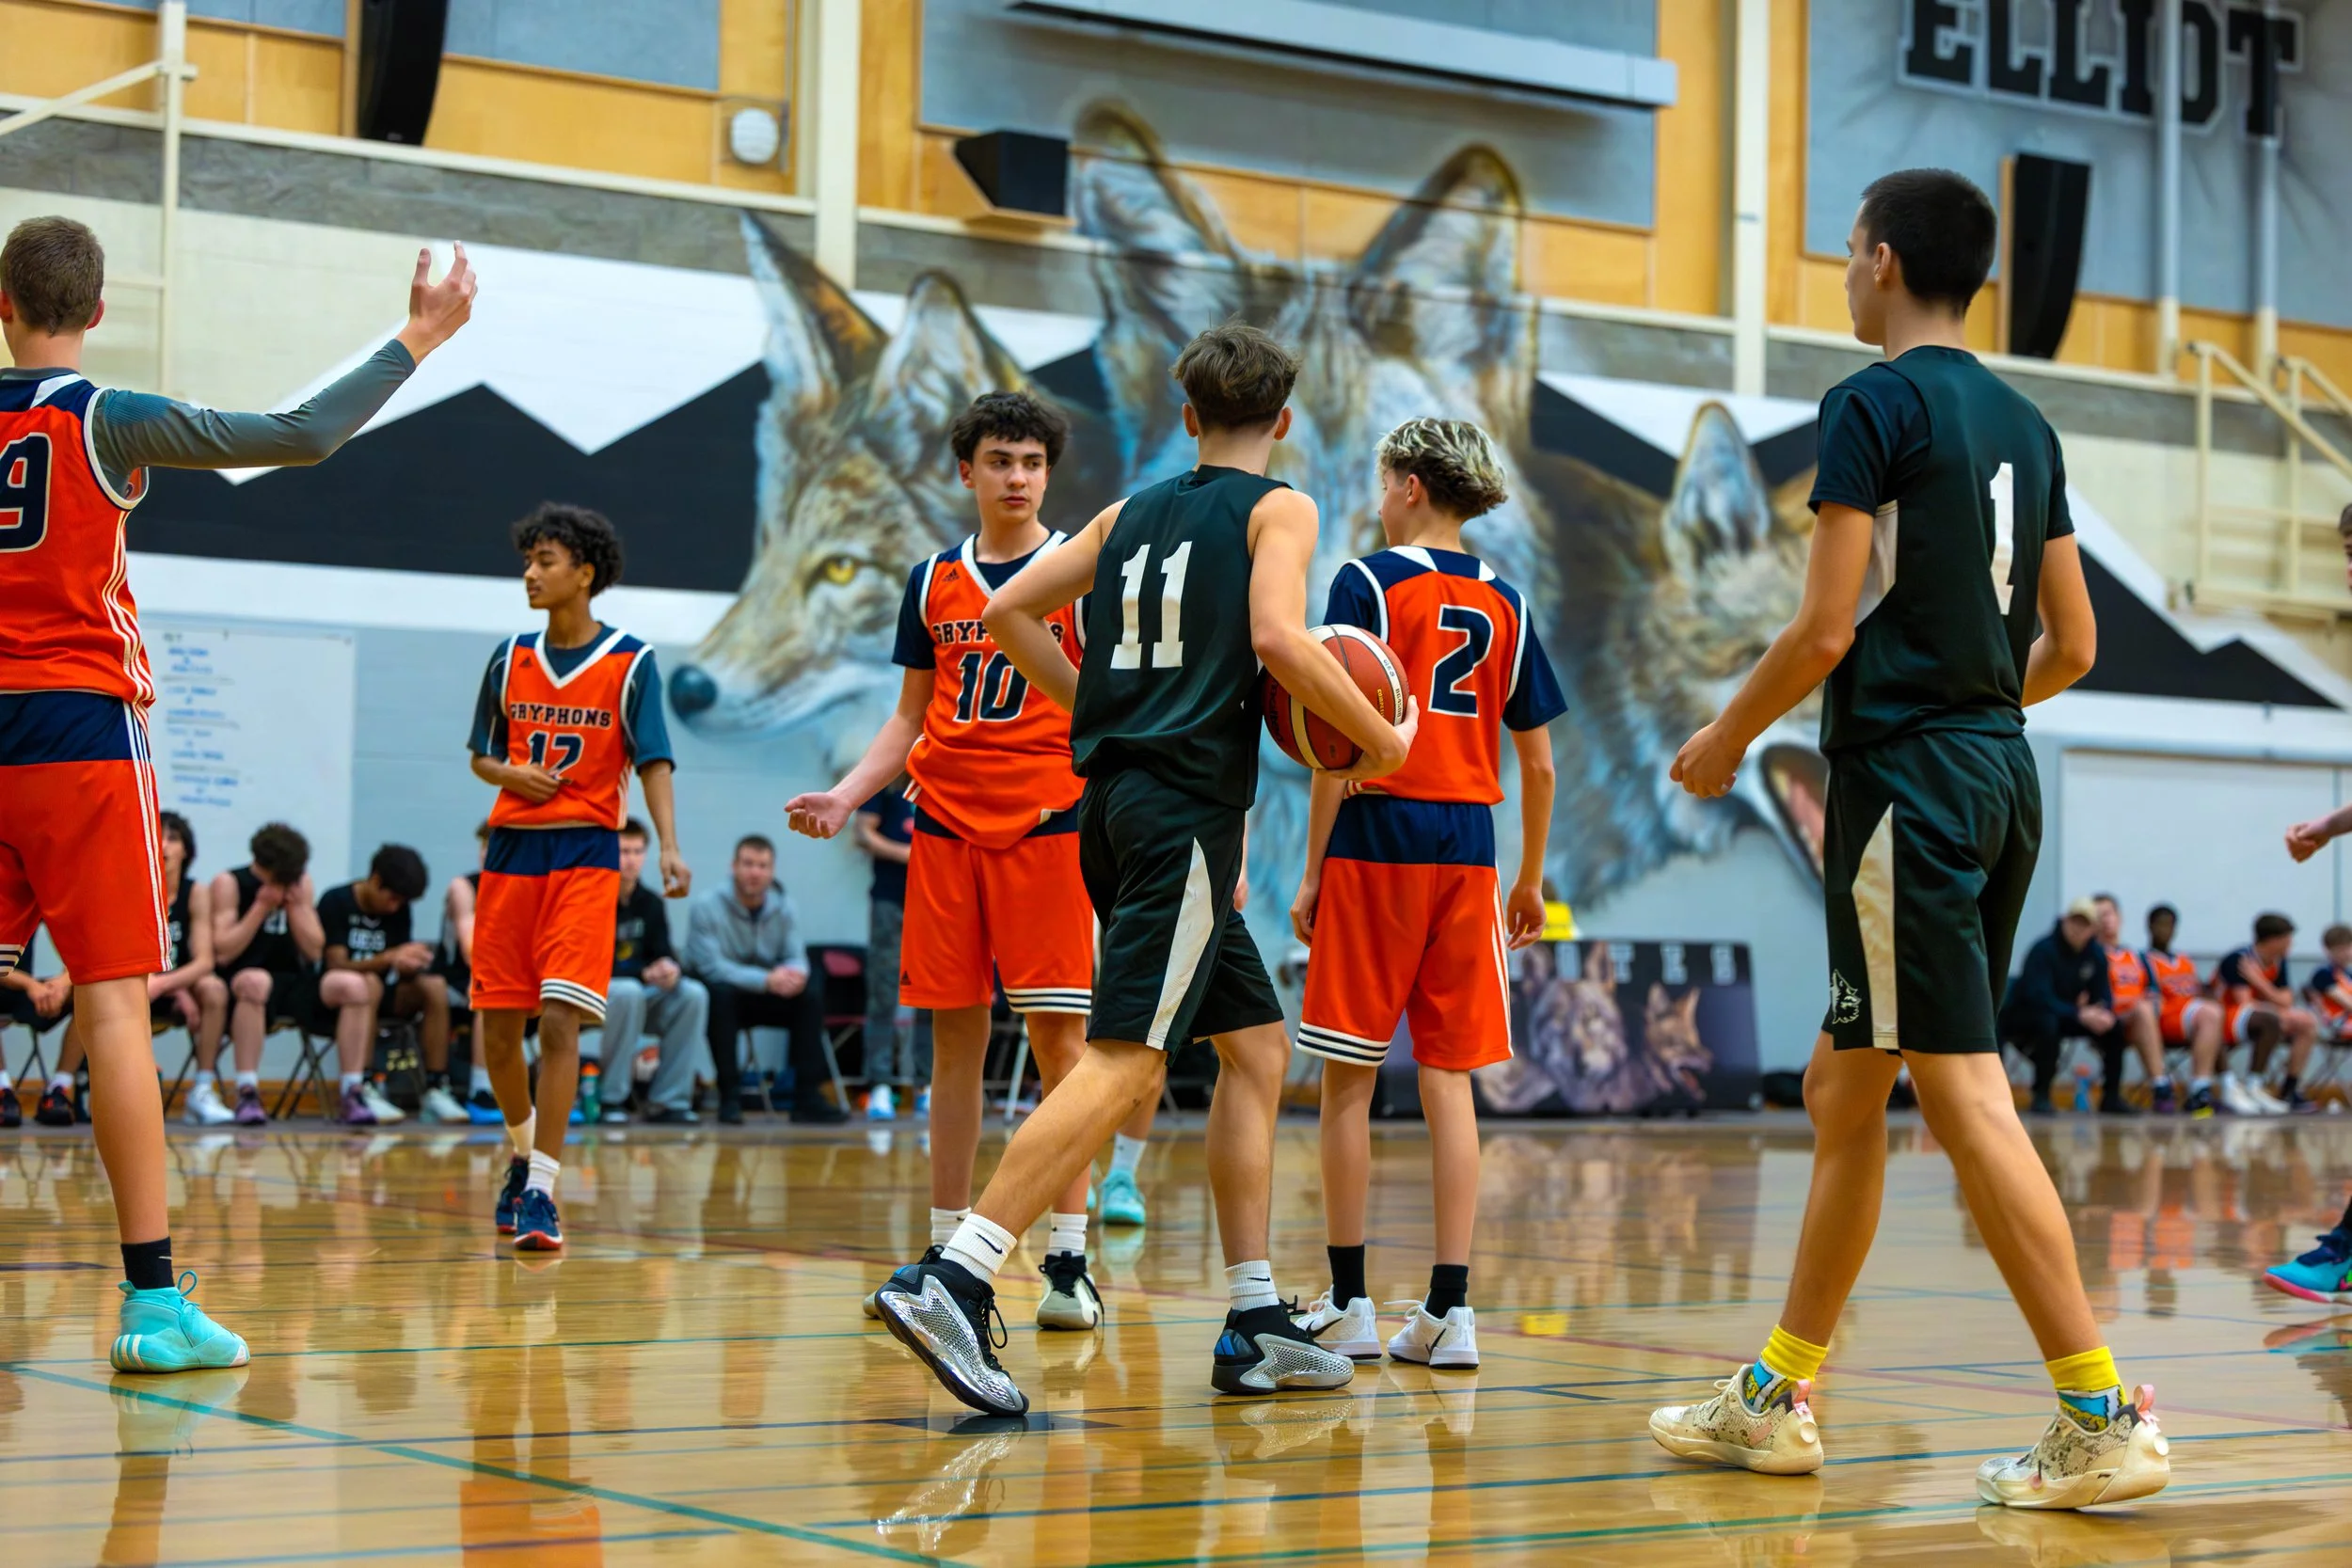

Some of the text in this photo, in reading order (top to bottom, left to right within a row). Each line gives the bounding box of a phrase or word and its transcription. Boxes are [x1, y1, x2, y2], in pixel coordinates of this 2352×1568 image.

[1901, 0, 2303, 138] ELLIOT
[1989, 462, 2014, 615] 1
[1110, 541, 1193, 669] 11
[1427, 603, 1494, 718] 2
[509, 701, 612, 730] GRYPHONS
[952, 650, 1029, 723] 10
